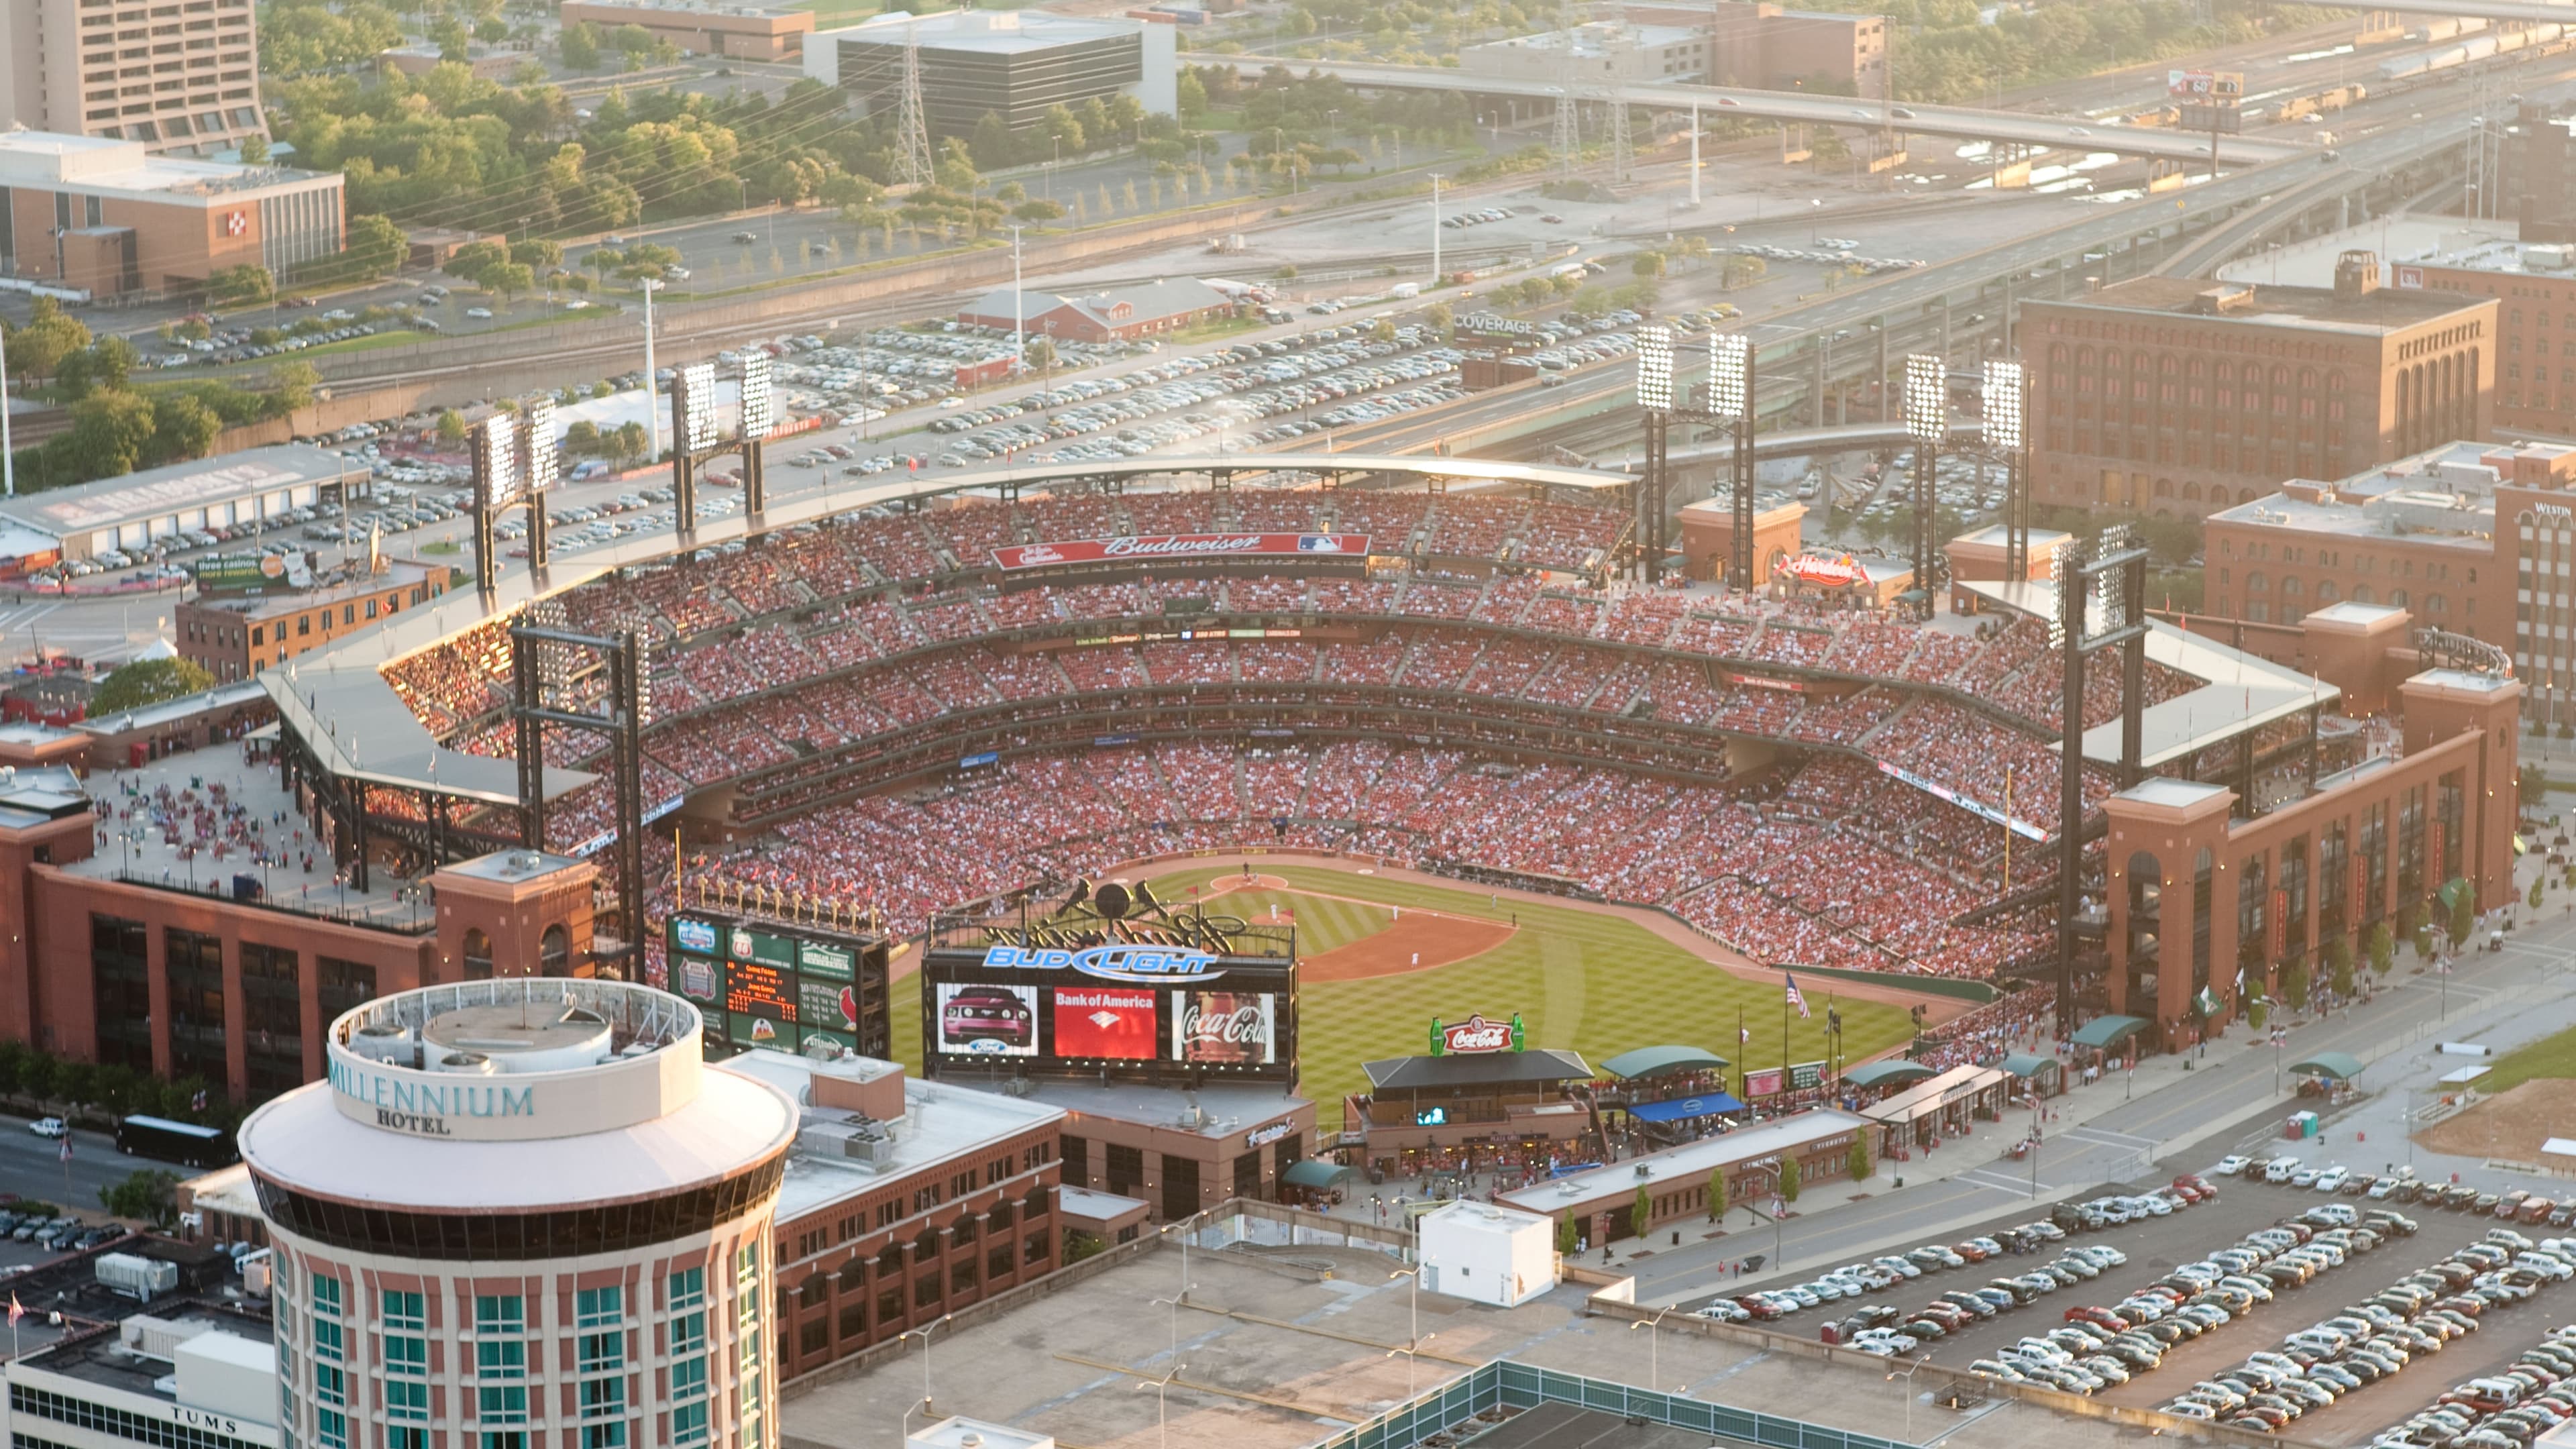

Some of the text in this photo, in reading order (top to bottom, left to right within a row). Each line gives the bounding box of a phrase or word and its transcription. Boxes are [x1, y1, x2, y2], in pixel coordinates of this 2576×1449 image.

[1454, 315, 1534, 333] COVERAGE
[2534, 501, 2571, 516] WESTIN
[1104, 535, 1260, 555] Budweiser
[199, 561, 221, 571] three
[199, 571, 222, 580] more
[983, 947, 1218, 973] BUD LIGHT
[1055, 993, 1154, 1009] Bank of America
[1182, 1005, 1267, 1044] Coca-Cola
[1452, 1028, 1505, 1049] Coca-Cola
[329, 1055, 535, 1117] MILLENNIUM
[376, 1108, 451, 1135] HOTEL
[170, 1405, 236, 1434] TUMS
